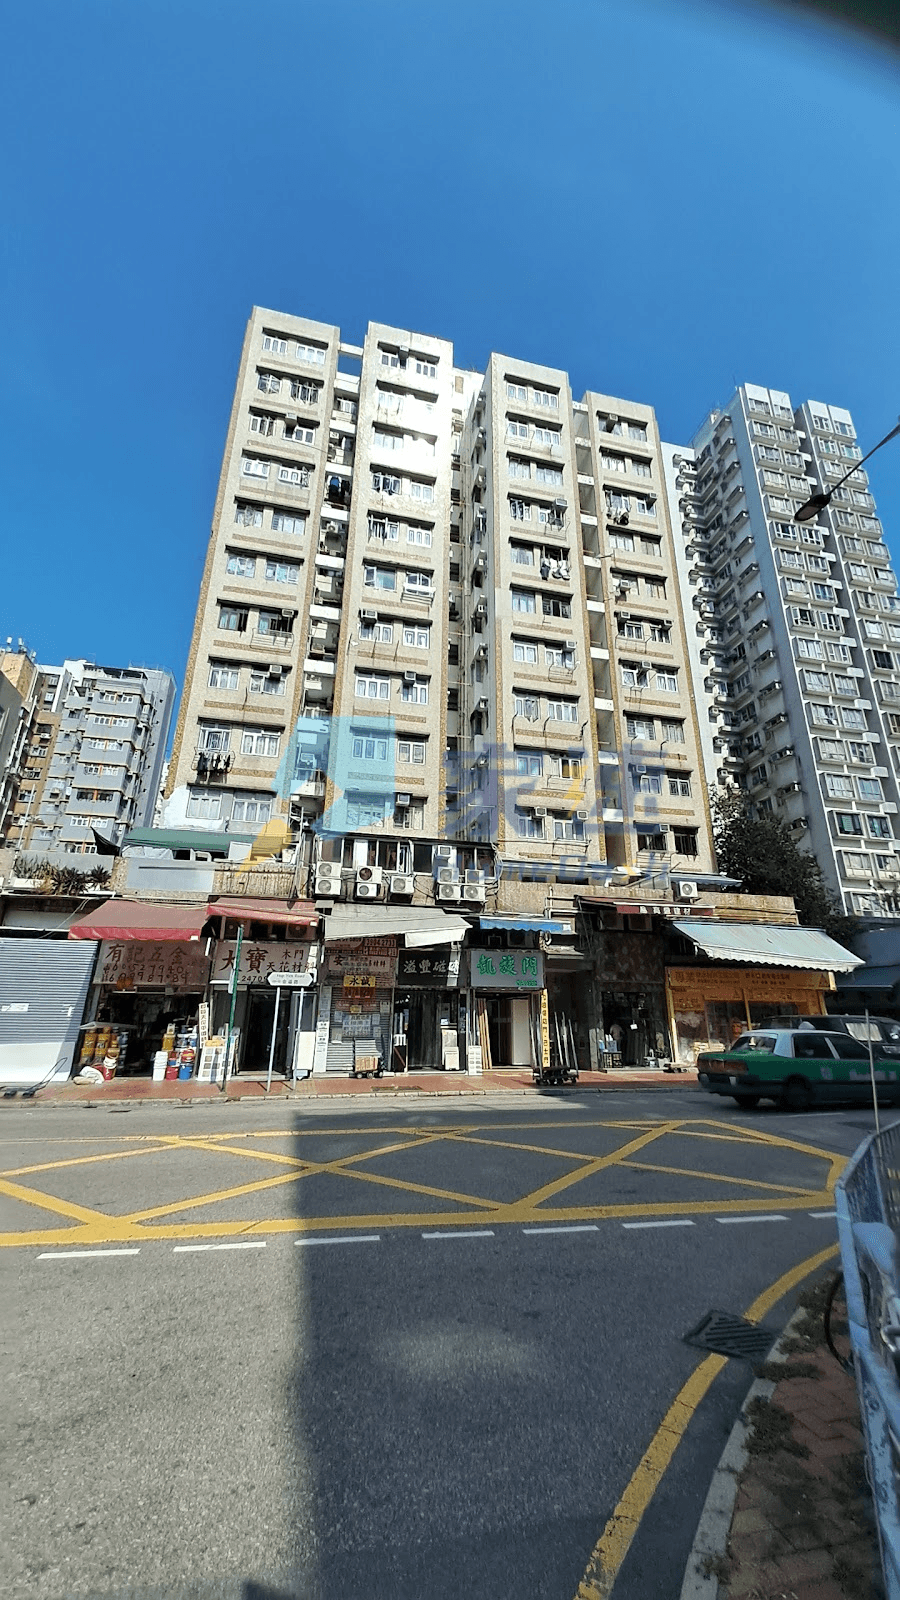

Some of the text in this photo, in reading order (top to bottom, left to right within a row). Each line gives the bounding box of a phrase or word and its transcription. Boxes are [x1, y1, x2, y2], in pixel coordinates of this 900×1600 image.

[105, 943, 188, 965] 有記五金
[219, 946, 269, 973] 大寶
[281, 949, 304, 960] 木門
[476, 953, 537, 976] 凱旋門
